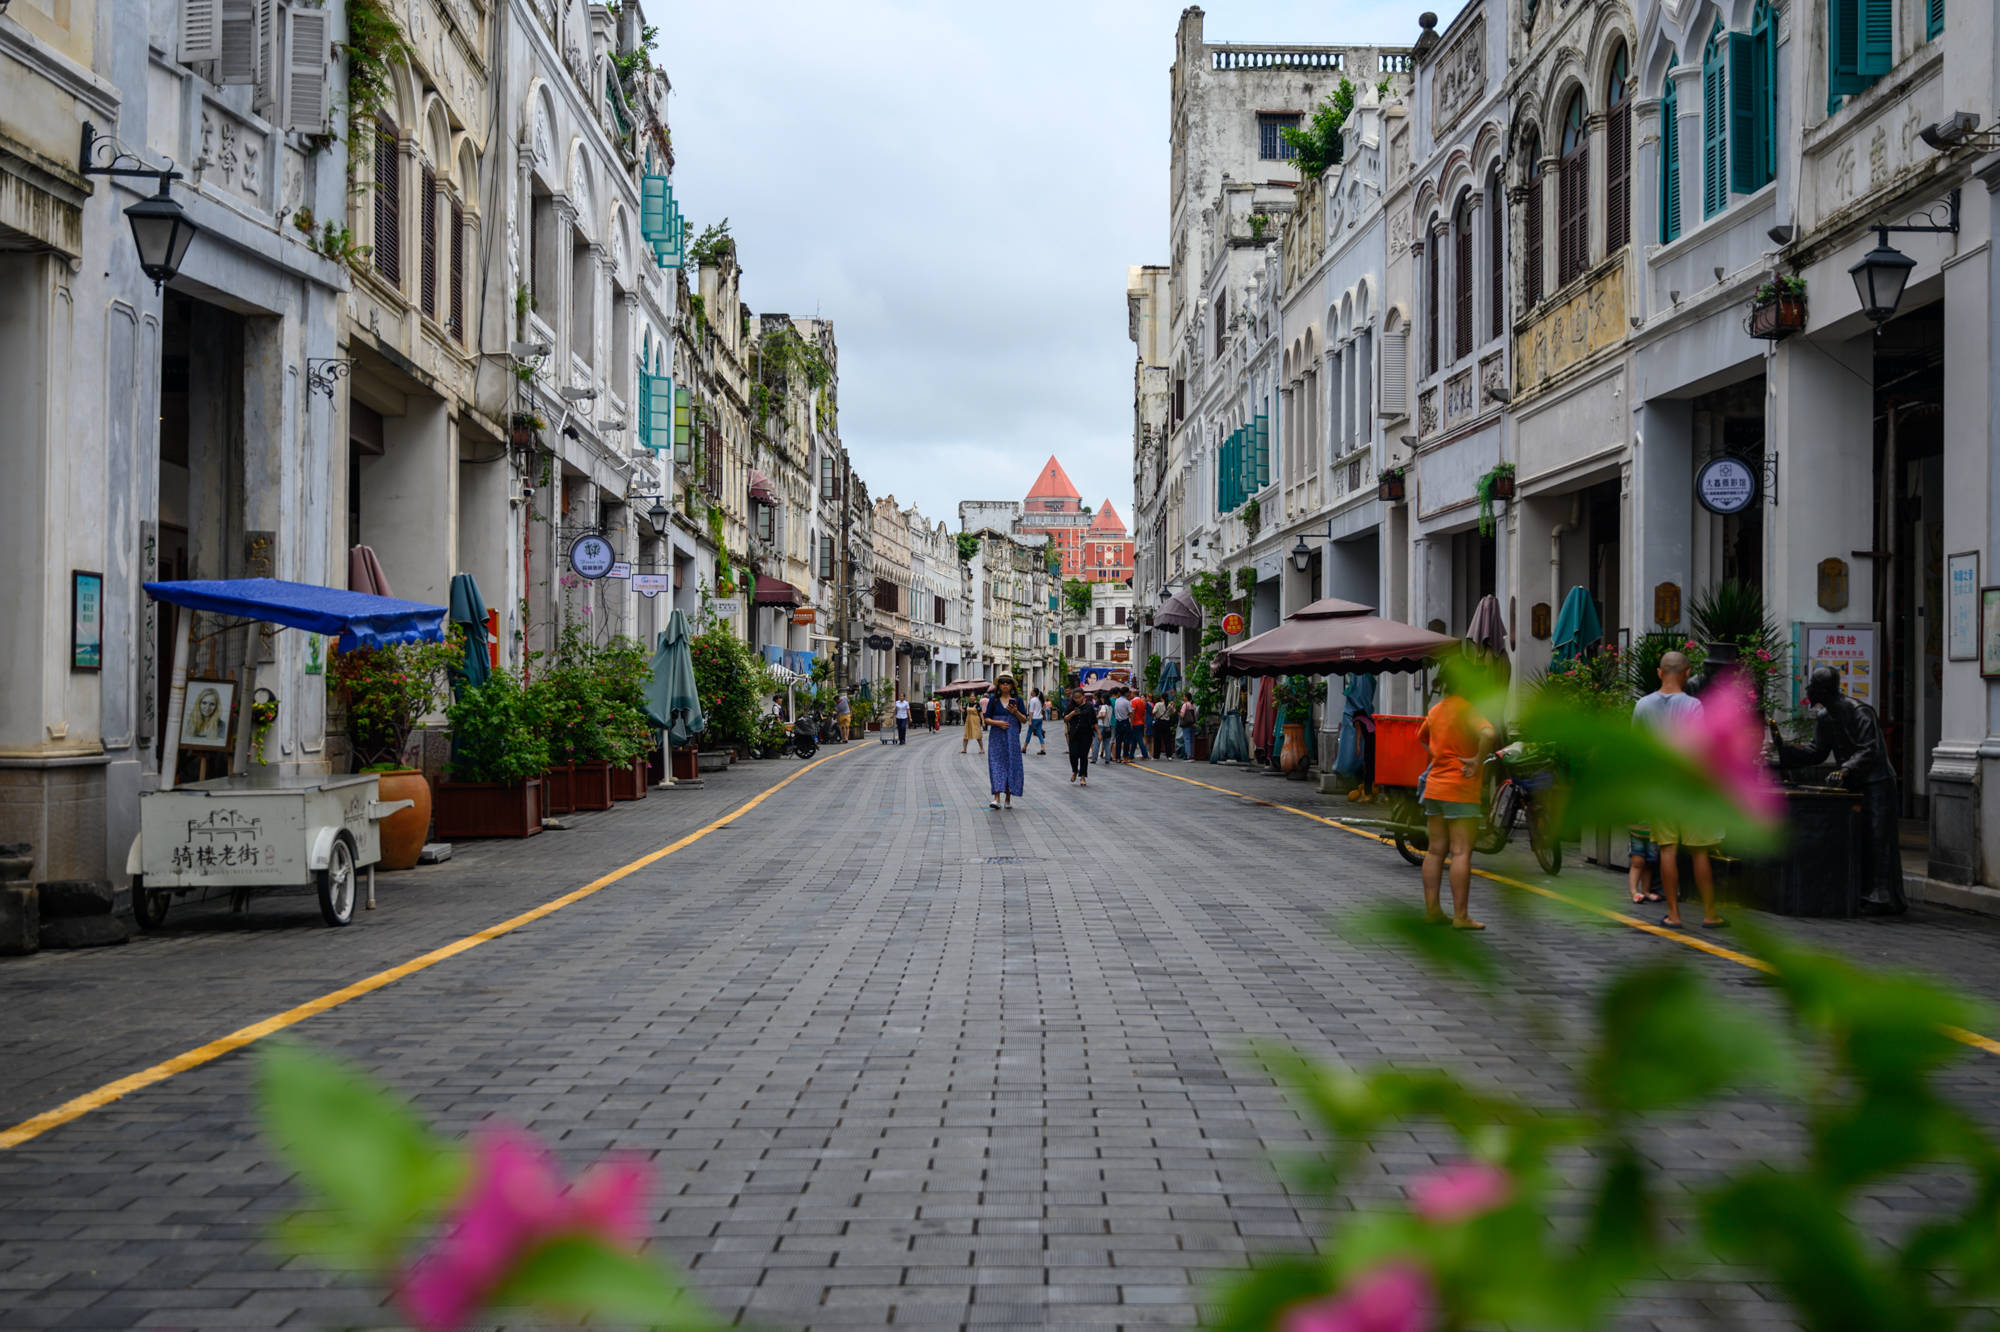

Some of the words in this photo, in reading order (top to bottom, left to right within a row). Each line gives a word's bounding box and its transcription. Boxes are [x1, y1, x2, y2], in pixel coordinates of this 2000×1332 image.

[1825, 634, 1857, 645] 消防栓
[171, 843, 260, 869] 骑楼老街
